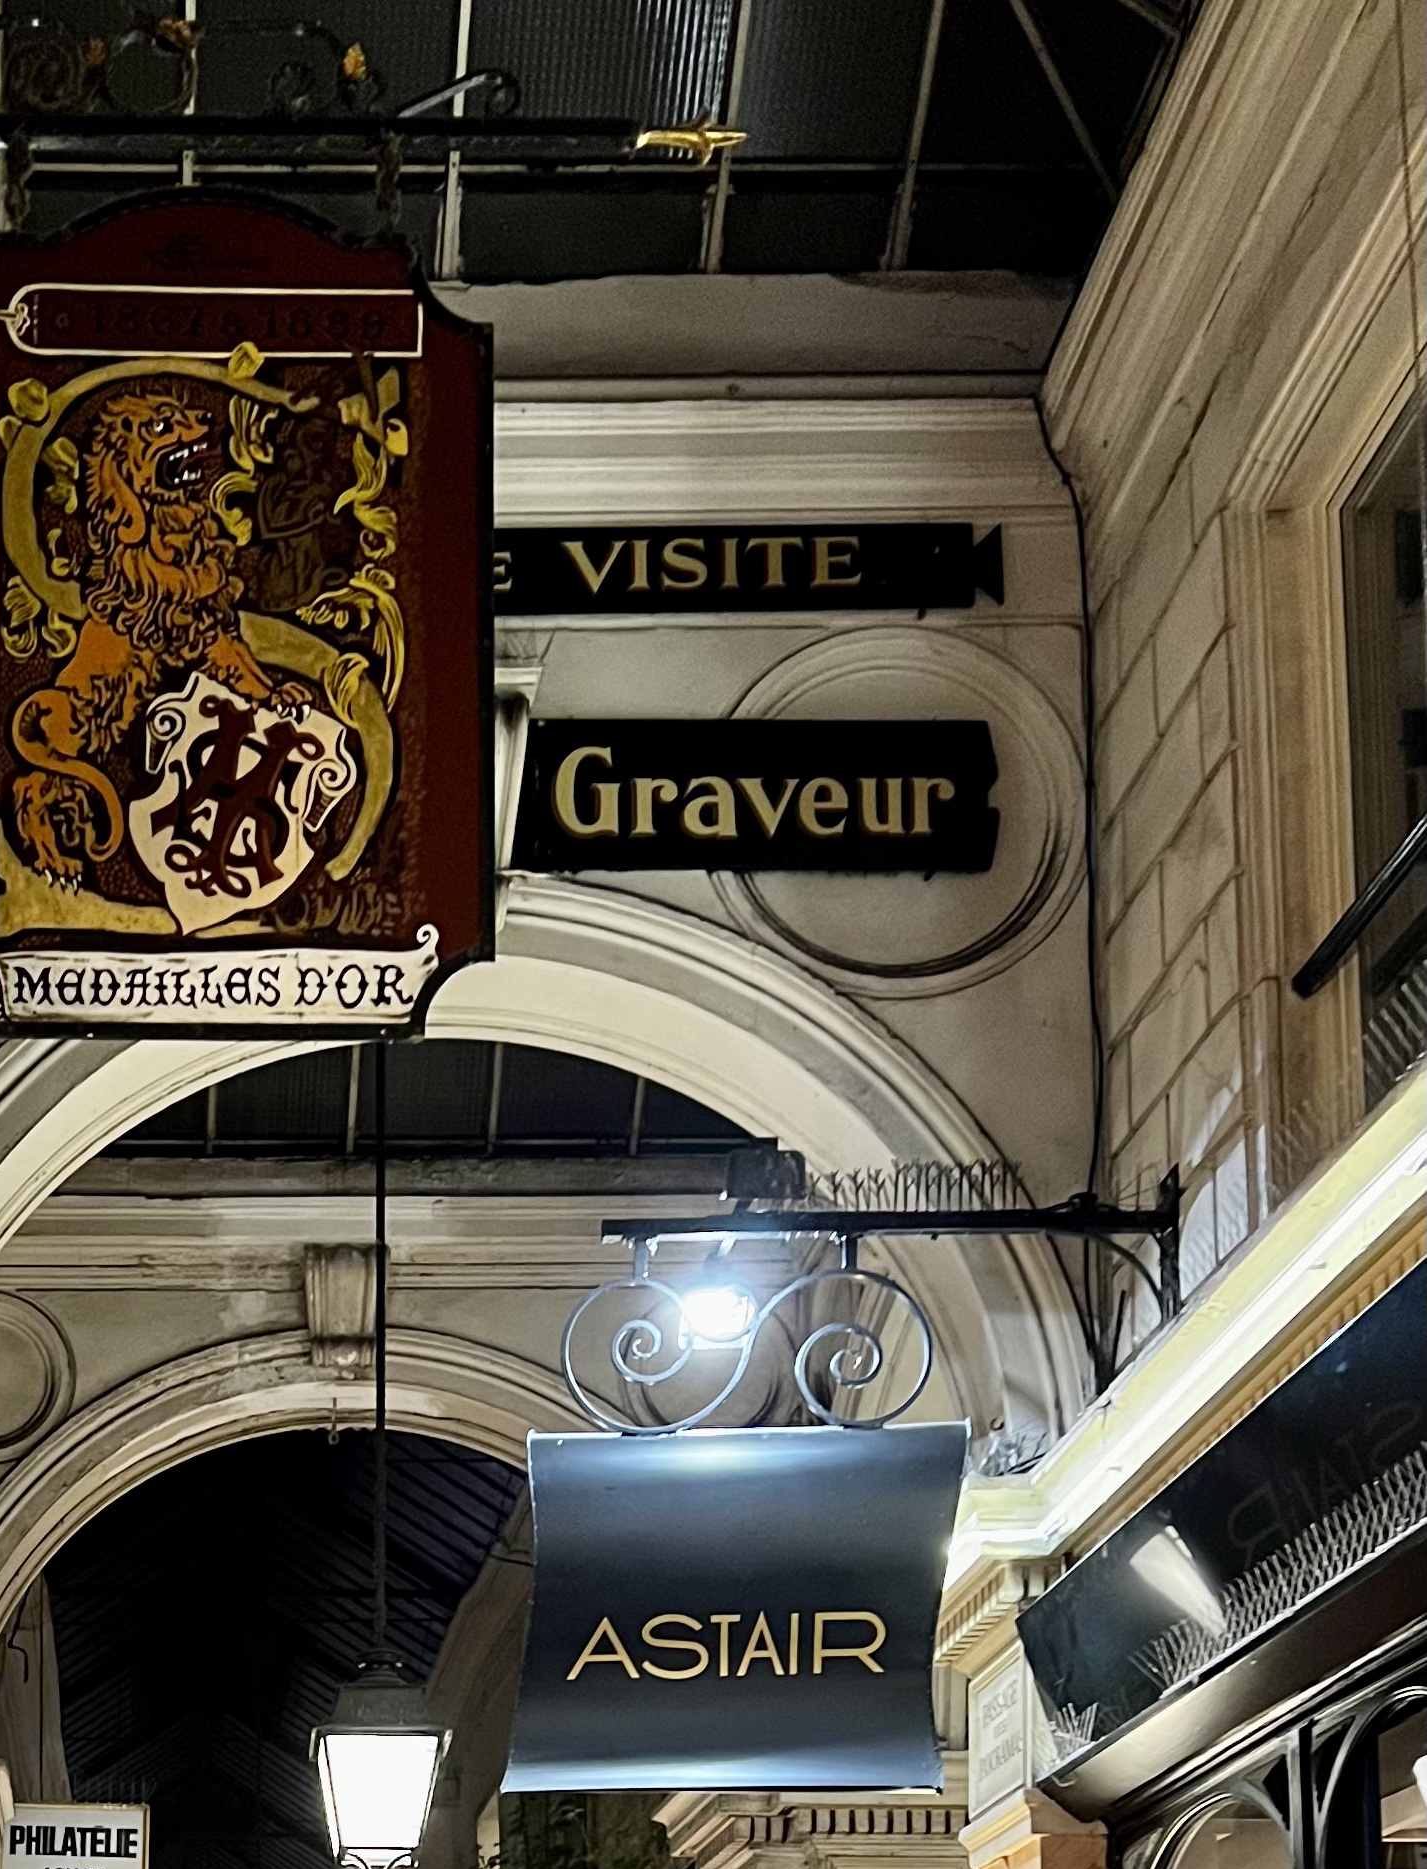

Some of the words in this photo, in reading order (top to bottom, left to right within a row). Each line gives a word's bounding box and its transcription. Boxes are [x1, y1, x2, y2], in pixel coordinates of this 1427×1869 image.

[561, 535, 862, 596] VISITE
[551, 746, 956, 840] Graveur
[294, 963, 414, 1010] D'OR
[566, 1611, 886, 1680] ASTAIR
